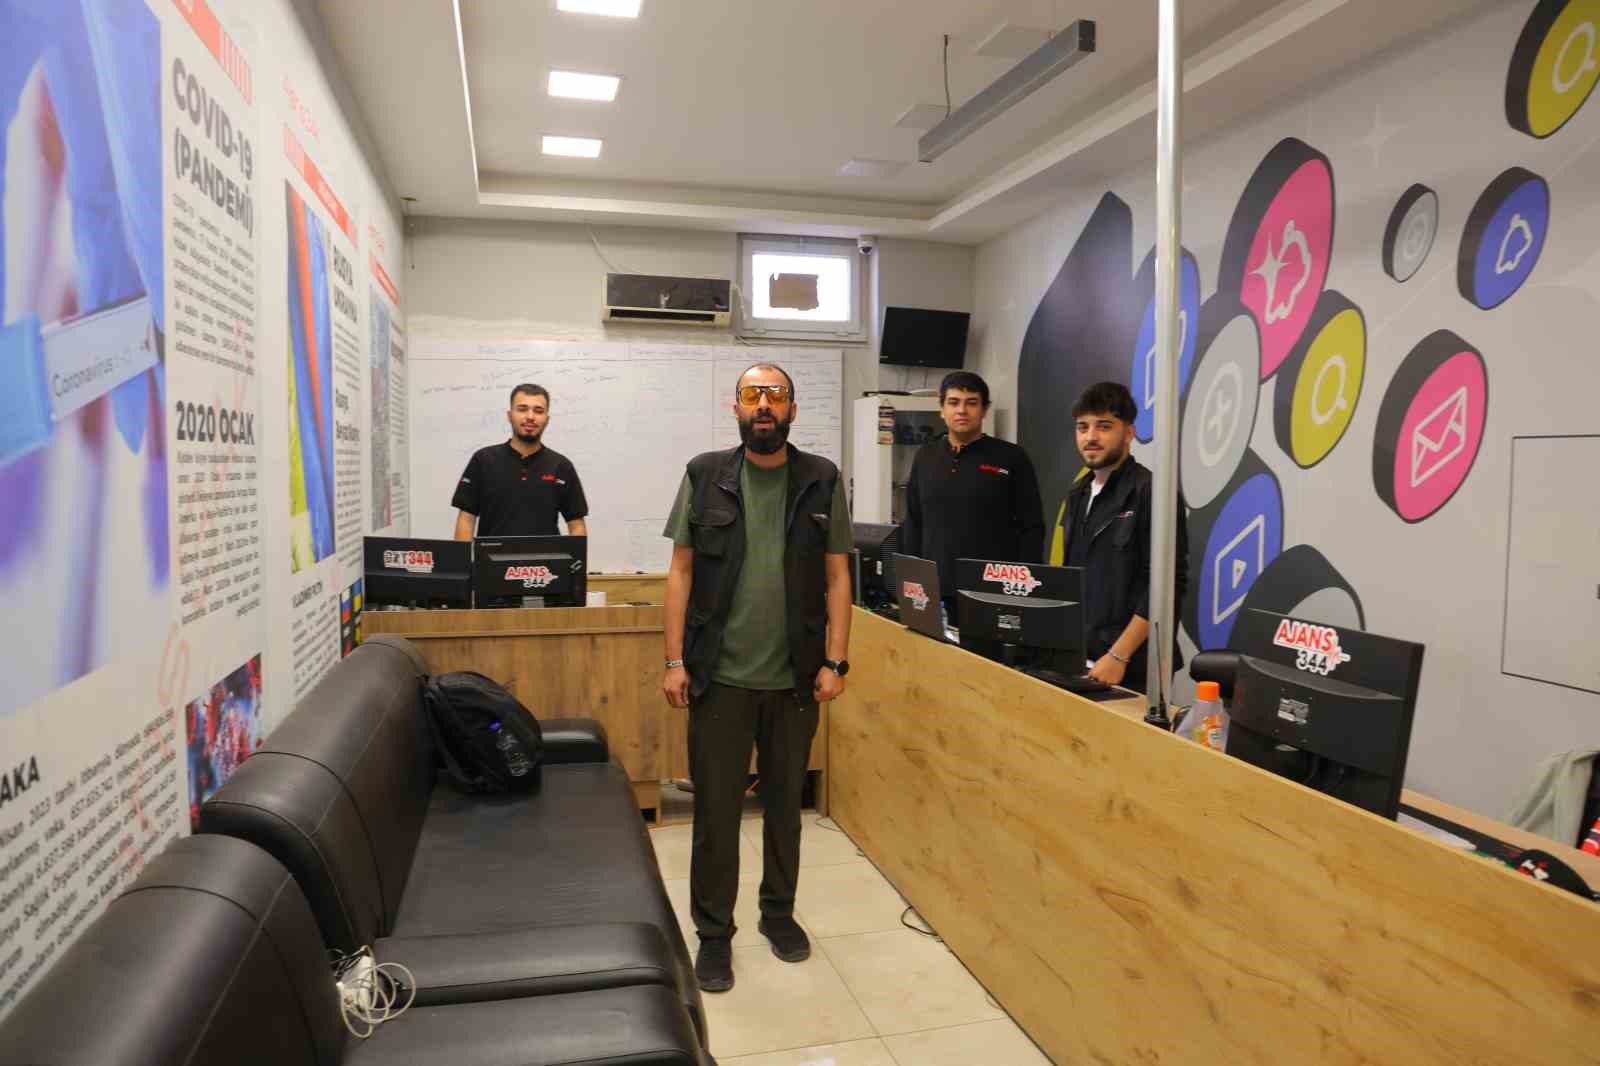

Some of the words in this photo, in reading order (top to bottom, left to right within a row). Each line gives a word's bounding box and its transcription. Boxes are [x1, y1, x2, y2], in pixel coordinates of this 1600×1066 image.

[172, 57, 253, 181] COVID-19
[176, 399, 216, 443] 2020
[219, 407, 256, 446] OCAK
[507, 566, 547, 578] AJANS
[984, 563, 1029, 581] AJANS
[1004, 581, 1029, 596] 344
[1276, 620, 1335, 653] AJANS
[1297, 650, 1329, 673] 344
